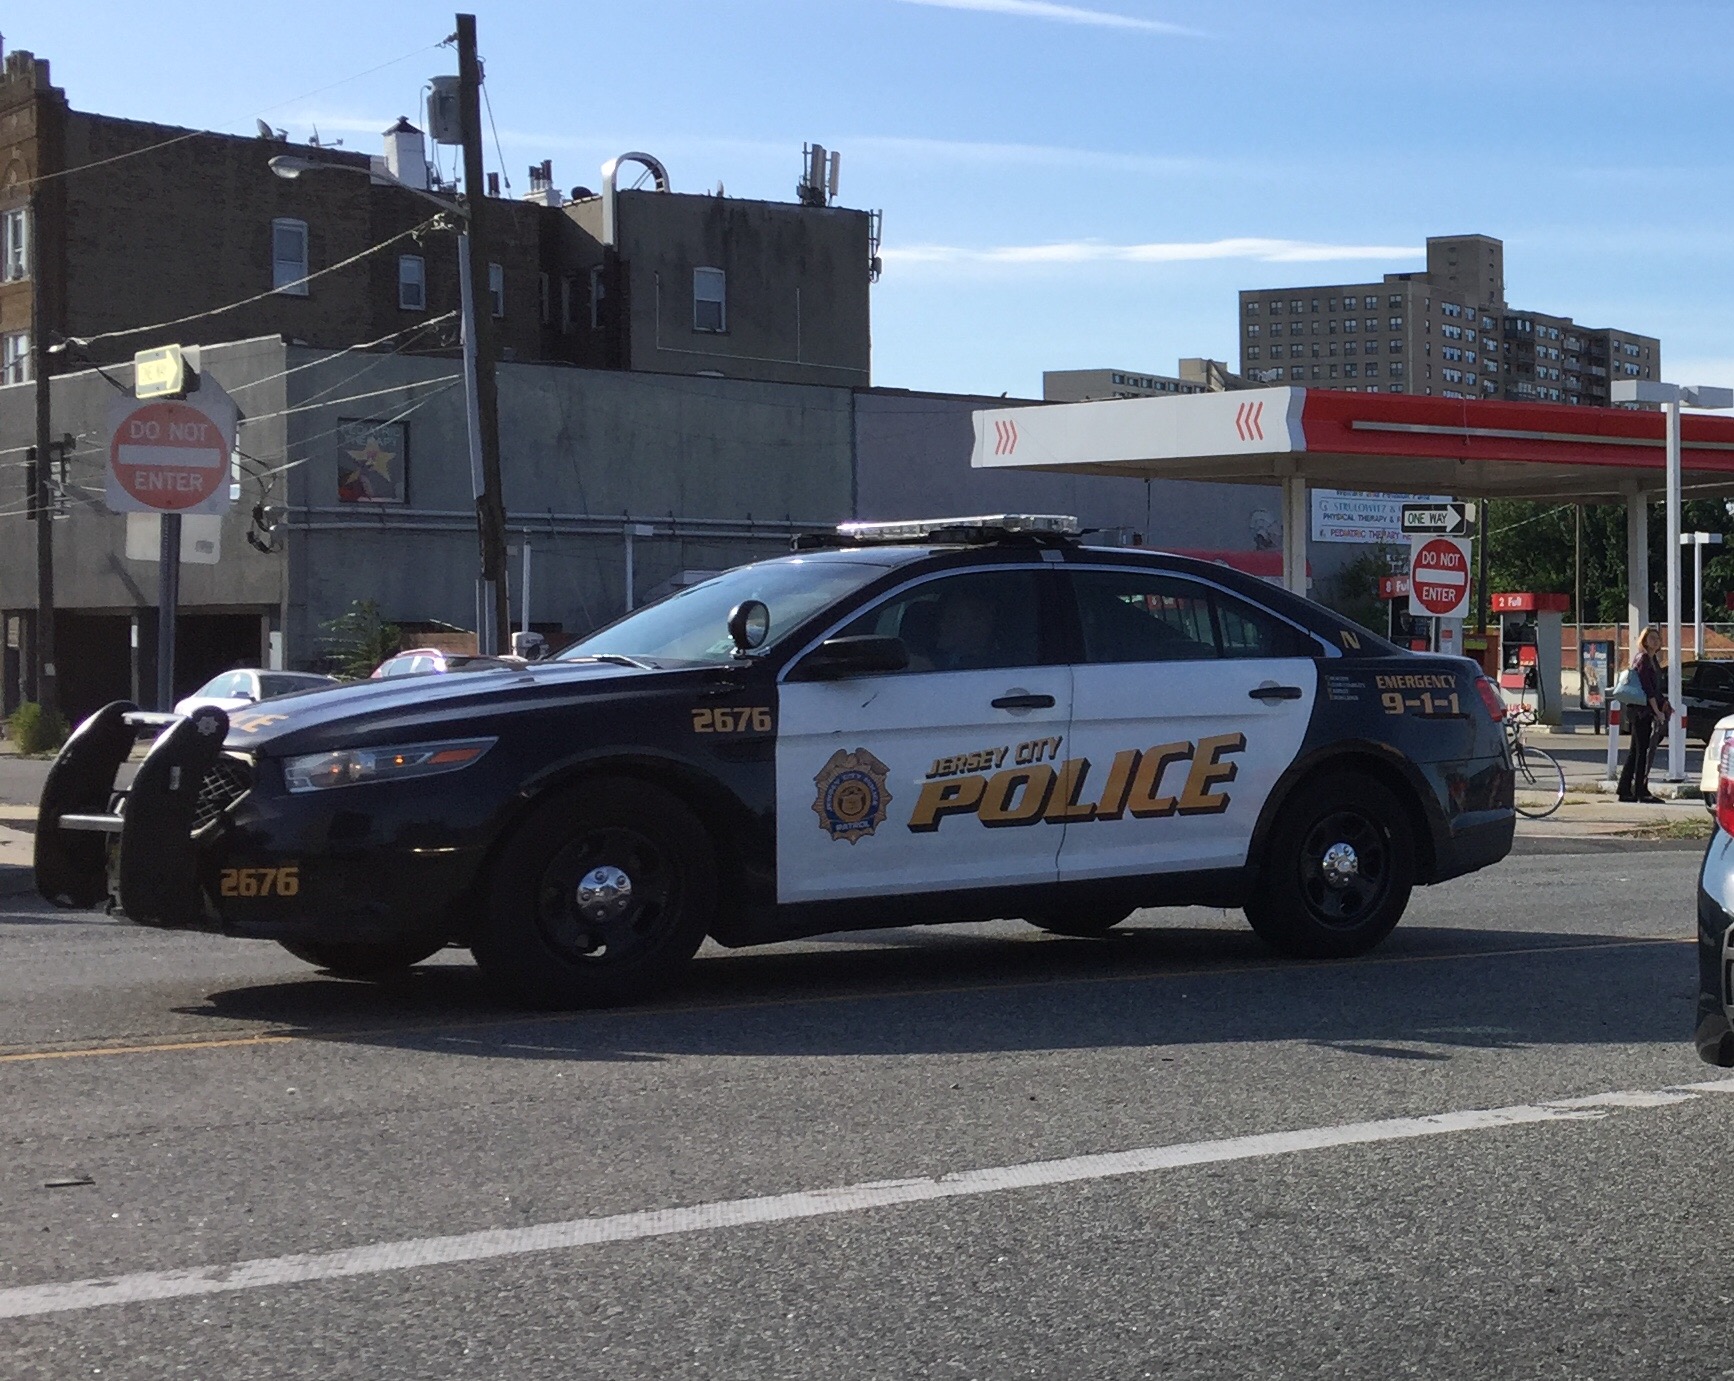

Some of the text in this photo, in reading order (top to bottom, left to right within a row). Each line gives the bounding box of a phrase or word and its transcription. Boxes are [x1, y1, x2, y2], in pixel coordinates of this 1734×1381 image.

[129, 420, 208, 441] DO NOT
[134, 471, 203, 492] ENTER
[1323, 513, 1355, 521] PHYSICAL
[1358, 514, 1387, 523] THERAPY
[1407, 513, 1425, 524] ONE
[1429, 513, 1447, 524] WAY
[1330, 529, 1366, 538] PEDIATRIC
[1369, 530, 1399, 540] THERAPY
[1422, 551, 1436, 565] DO
[1440, 553, 1460, 567] NOT
[1423, 587, 1456, 602] ENTER
[1499, 597, 1522, 607] 2 Full
[1340, 631, 1361, 649] N
[1375, 675, 1457, 689] EMERGENCY
[1381, 692, 1460, 714] 9-1-1
[691, 707, 772, 732] 2676
[926, 735, 1063, 779] JERSEY CITY
[907, 732, 1246, 833] POLICE
[835, 820, 871, 831] PATROL
[220, 867, 300, 896] 2676
